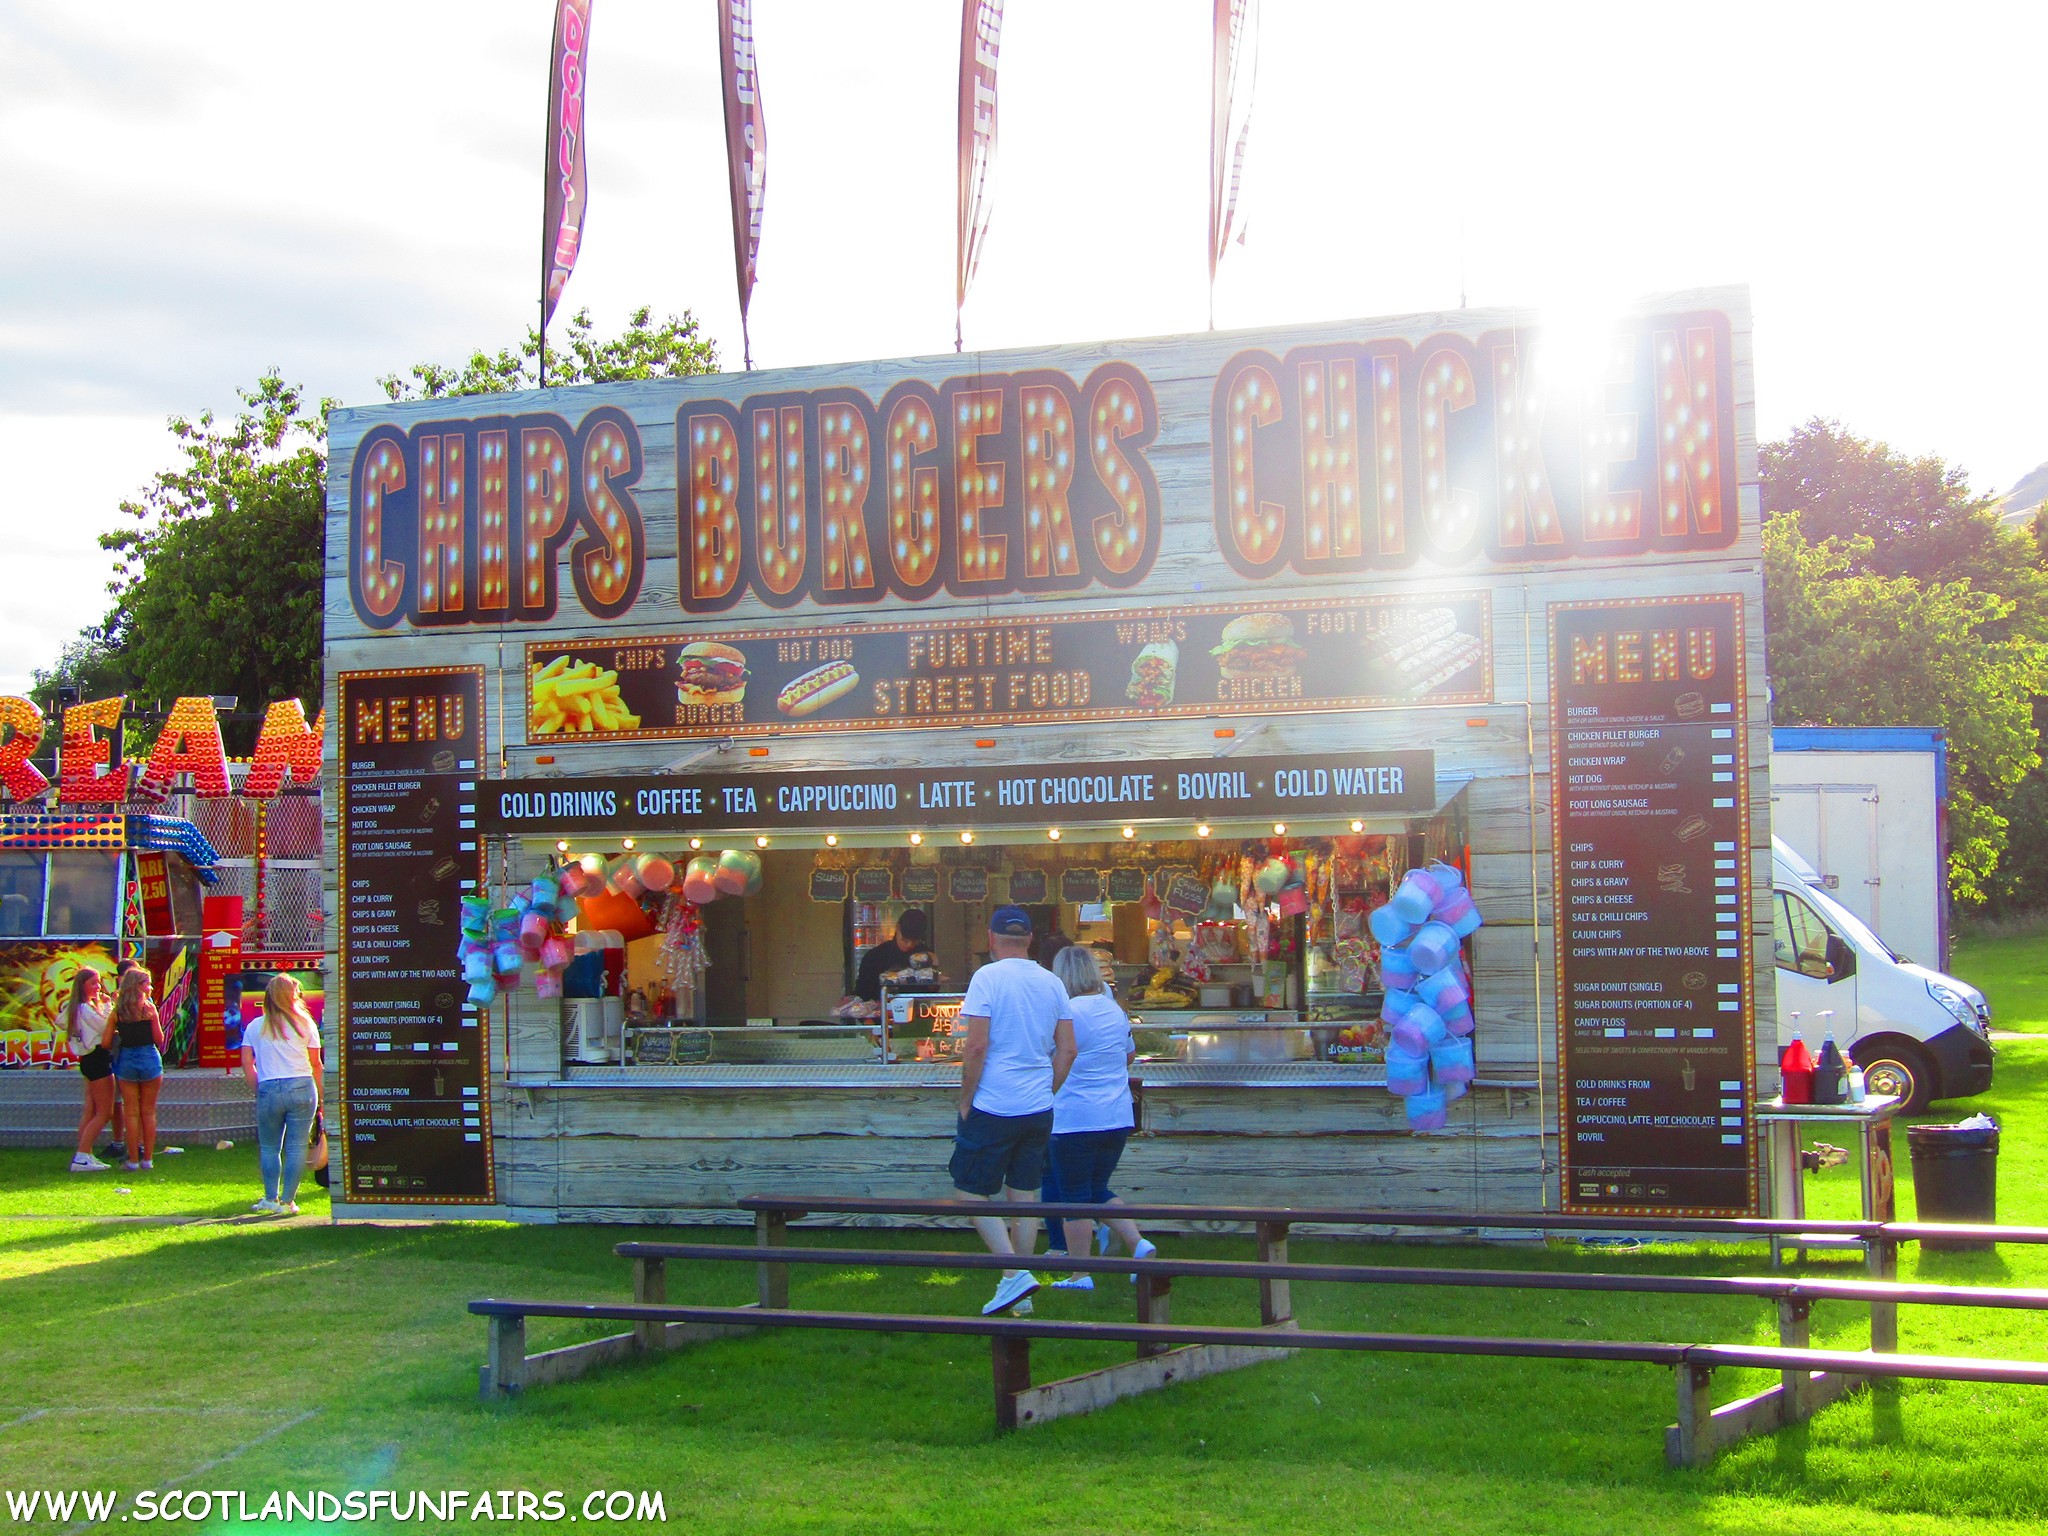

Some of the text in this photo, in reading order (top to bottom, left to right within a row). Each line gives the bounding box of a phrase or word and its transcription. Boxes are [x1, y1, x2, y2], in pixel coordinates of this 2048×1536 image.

[1226, 326, 1723, 564] CHICKEN
[689, 376, 1146, 598] BURGERS
[361, 420, 633, 617] CHIPS
[1308, 611, 1357, 634] FOOT
[1116, 621, 1187, 645] WRAPS
[778, 639, 854, 663] HOT DOG
[908, 627, 1052, 671] FUNTIME
[615, 649, 665, 671] CHIPS
[1571, 628, 1716, 684] MENU
[1217, 676, 1302, 698] CHICKEN
[873, 670, 1090, 716] STREET FOOD
[675, 702, 744, 725] BURGER
[1568, 707, 1598, 716] BURGER
[355, 694, 464, 744] MENU
[1568, 730, 1660, 741] CHICKEN FILLET BURGER
[352, 761, 375, 769] BURGER
[1569, 756, 1626, 766] CHICKEN WRAP
[1569, 775, 1602, 783] HOT DOG
[352, 783, 377, 791] CHICKEN
[501, 767, 1402, 818] COLD DRINKS COFFEE TEA CAPPUCCINO LATTE HOT CHOCOLATE BOVRIL COLD WATER
[1591, 800, 1610, 808] LONG
[1613, 799, 1648, 808] SAUSAGE
[368, 842, 383, 850] LONG
[1571, 843, 1593, 851] CHIPS
[1571, 860, 1624, 869] CHIP & CURRY
[1571, 878, 1629, 886] CHIPS & GRAVY
[1572, 895, 1633, 904] CHIPS & CHEESE
[125, 881, 139, 937] PAY
[1572, 912, 1648, 921] SALT & CHILLI CHIPS
[1573, 930, 1621, 939] CAJUN CHIPS
[1573, 948, 1595, 956] CHIPS
[1597, 948, 1618, 956] WITH
[1619, 948, 1634, 956] ANY
[1664, 947, 1681, 955] TWO
[1684, 947, 1709, 955] ABOVE
[408, 970, 420, 978] THE
[1574, 982, 1662, 992] SUGAR DONUT (SINGLE)
[374, 1001, 393, 1009] DONUT
[395, 1001, 420, 1009] (SINGLE)
[1574, 1000, 1692, 1009] SUGAR DONUTS (PORTION OF 4)
[399, 1016, 426, 1024] (PORTION
[437, 1016, 442, 1024] 4)
[1602, 1018, 1625, 1026] FLOSS
[1576, 1080, 1596, 1088] COLD
[1598, 1080, 1626, 1088] DRINKS
[1577, 1098, 1626, 1106] TEA / COFFEE
[1577, 1116, 1715, 1125] CAPPUCCINO, LATTE, HOT CHOCOLATE
[1578, 1133, 1604, 1141] BOVRIL
[1598, 1169, 1630, 1178] accepted
